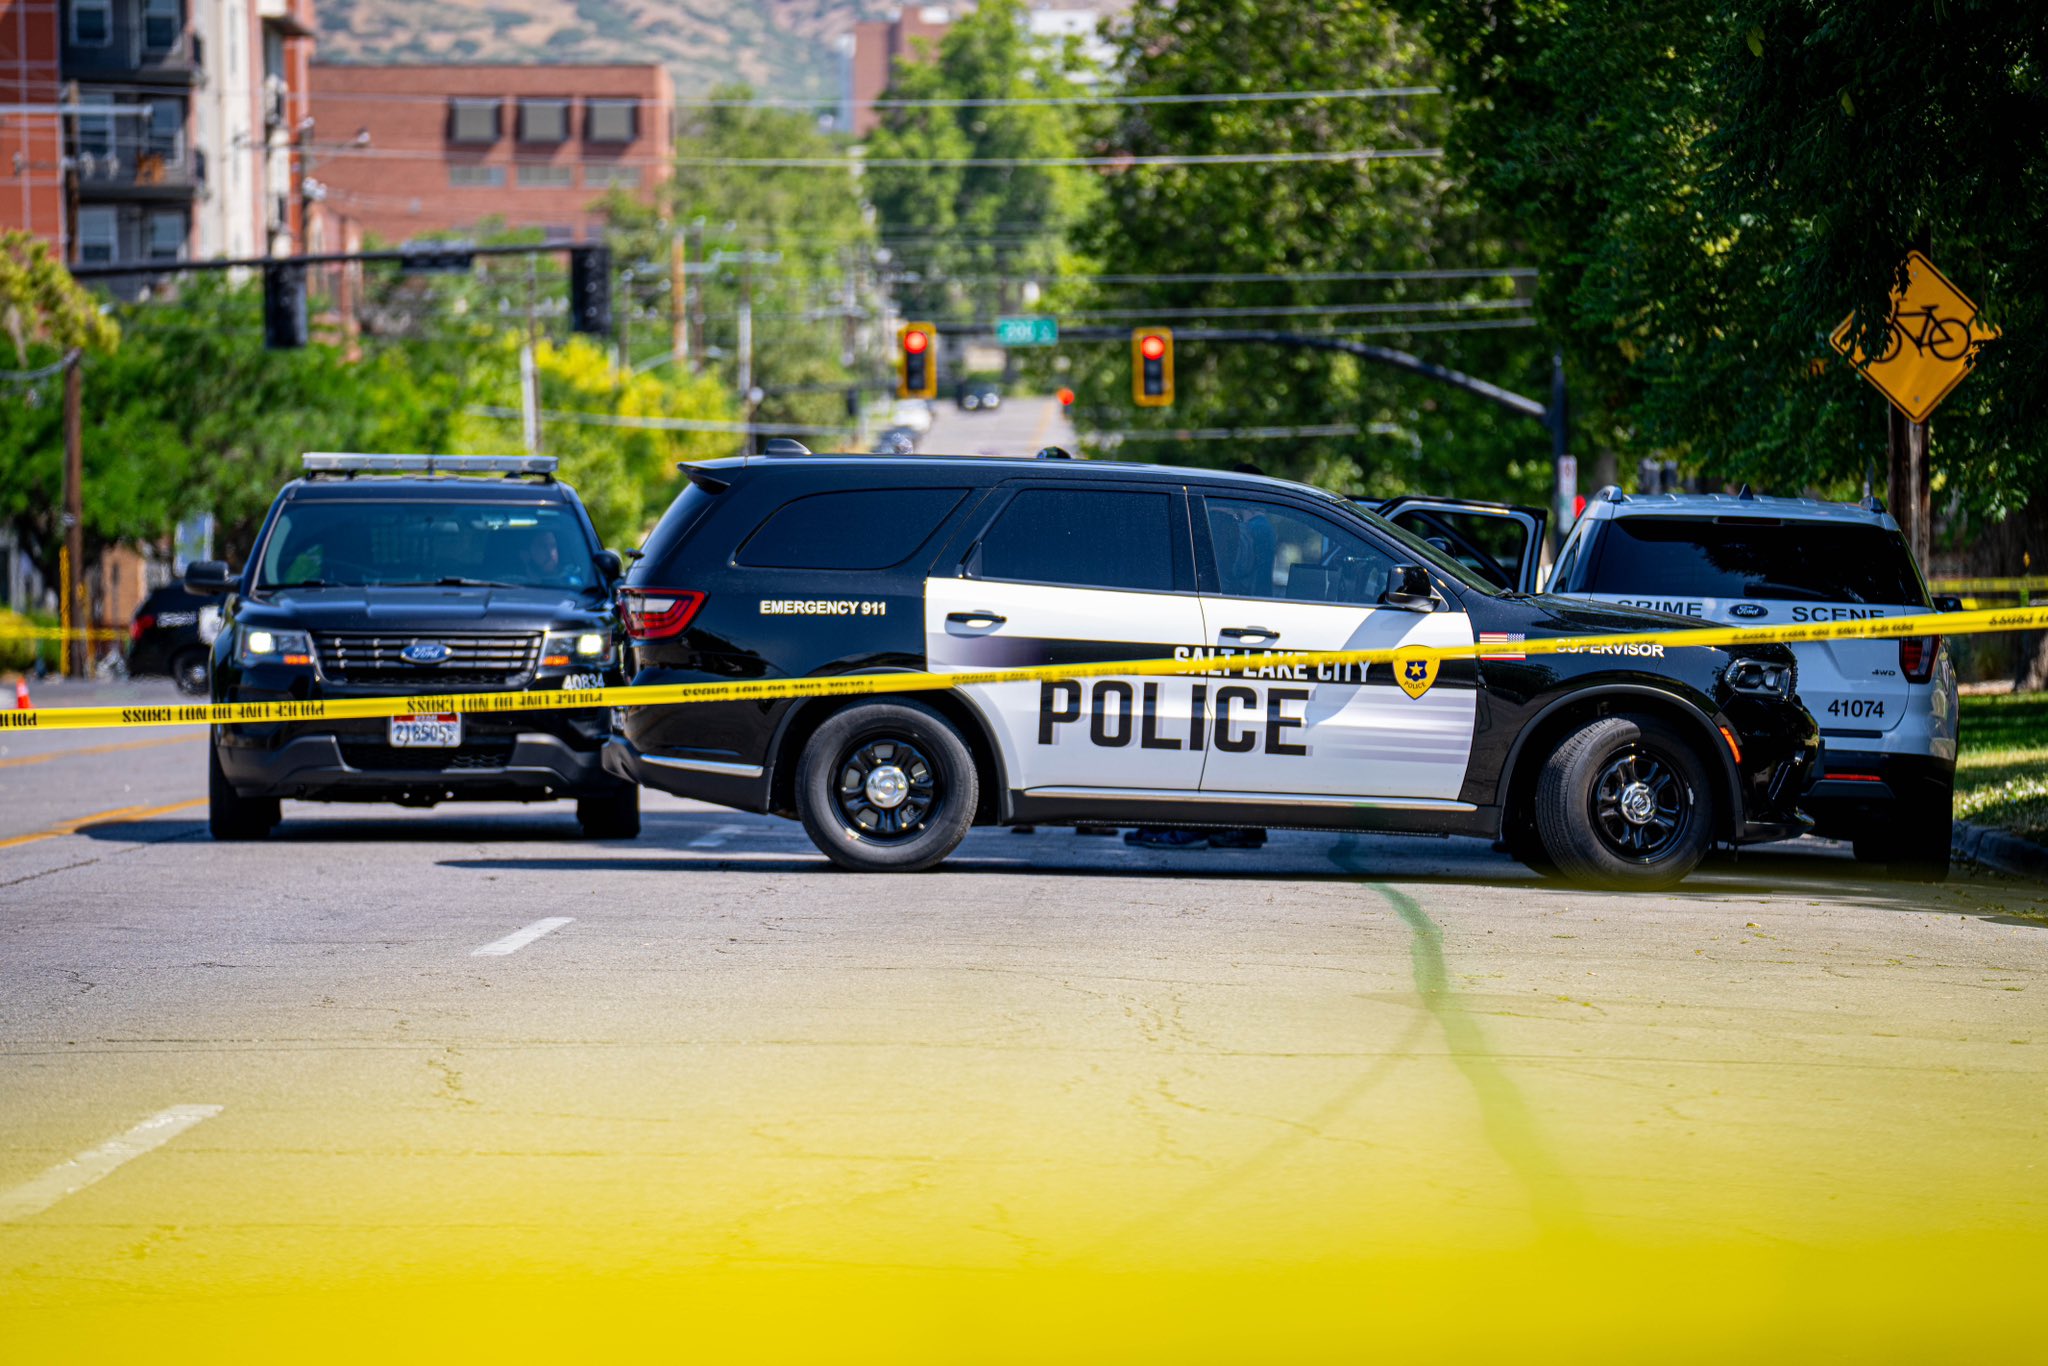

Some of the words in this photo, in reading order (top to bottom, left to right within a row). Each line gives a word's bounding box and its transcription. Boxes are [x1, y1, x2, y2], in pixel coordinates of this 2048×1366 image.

[760, 600, 859, 615] EMERGENCY
[861, 602, 886, 616] 911
[1736, 605, 1759, 616] Ford
[1792, 607, 1884, 622] SCENE
[411, 647, 441, 660] Ford
[1556, 639, 1664, 657] SUPERVISOR
[1174, 646, 1235, 677] SALT
[1242, 650, 1309, 680] LAKE
[1872, 669, 1896, 677] 4WD
[562, 673, 605, 690] 40834
[1404, 681, 1426, 690] POLICE
[122, 708, 171, 723] CROSS
[178, 707, 206, 721] NOT
[275, 702, 324, 718] POLICE
[1828, 699, 1885, 718] 41074
[1038, 678, 1310, 756] POLICE
